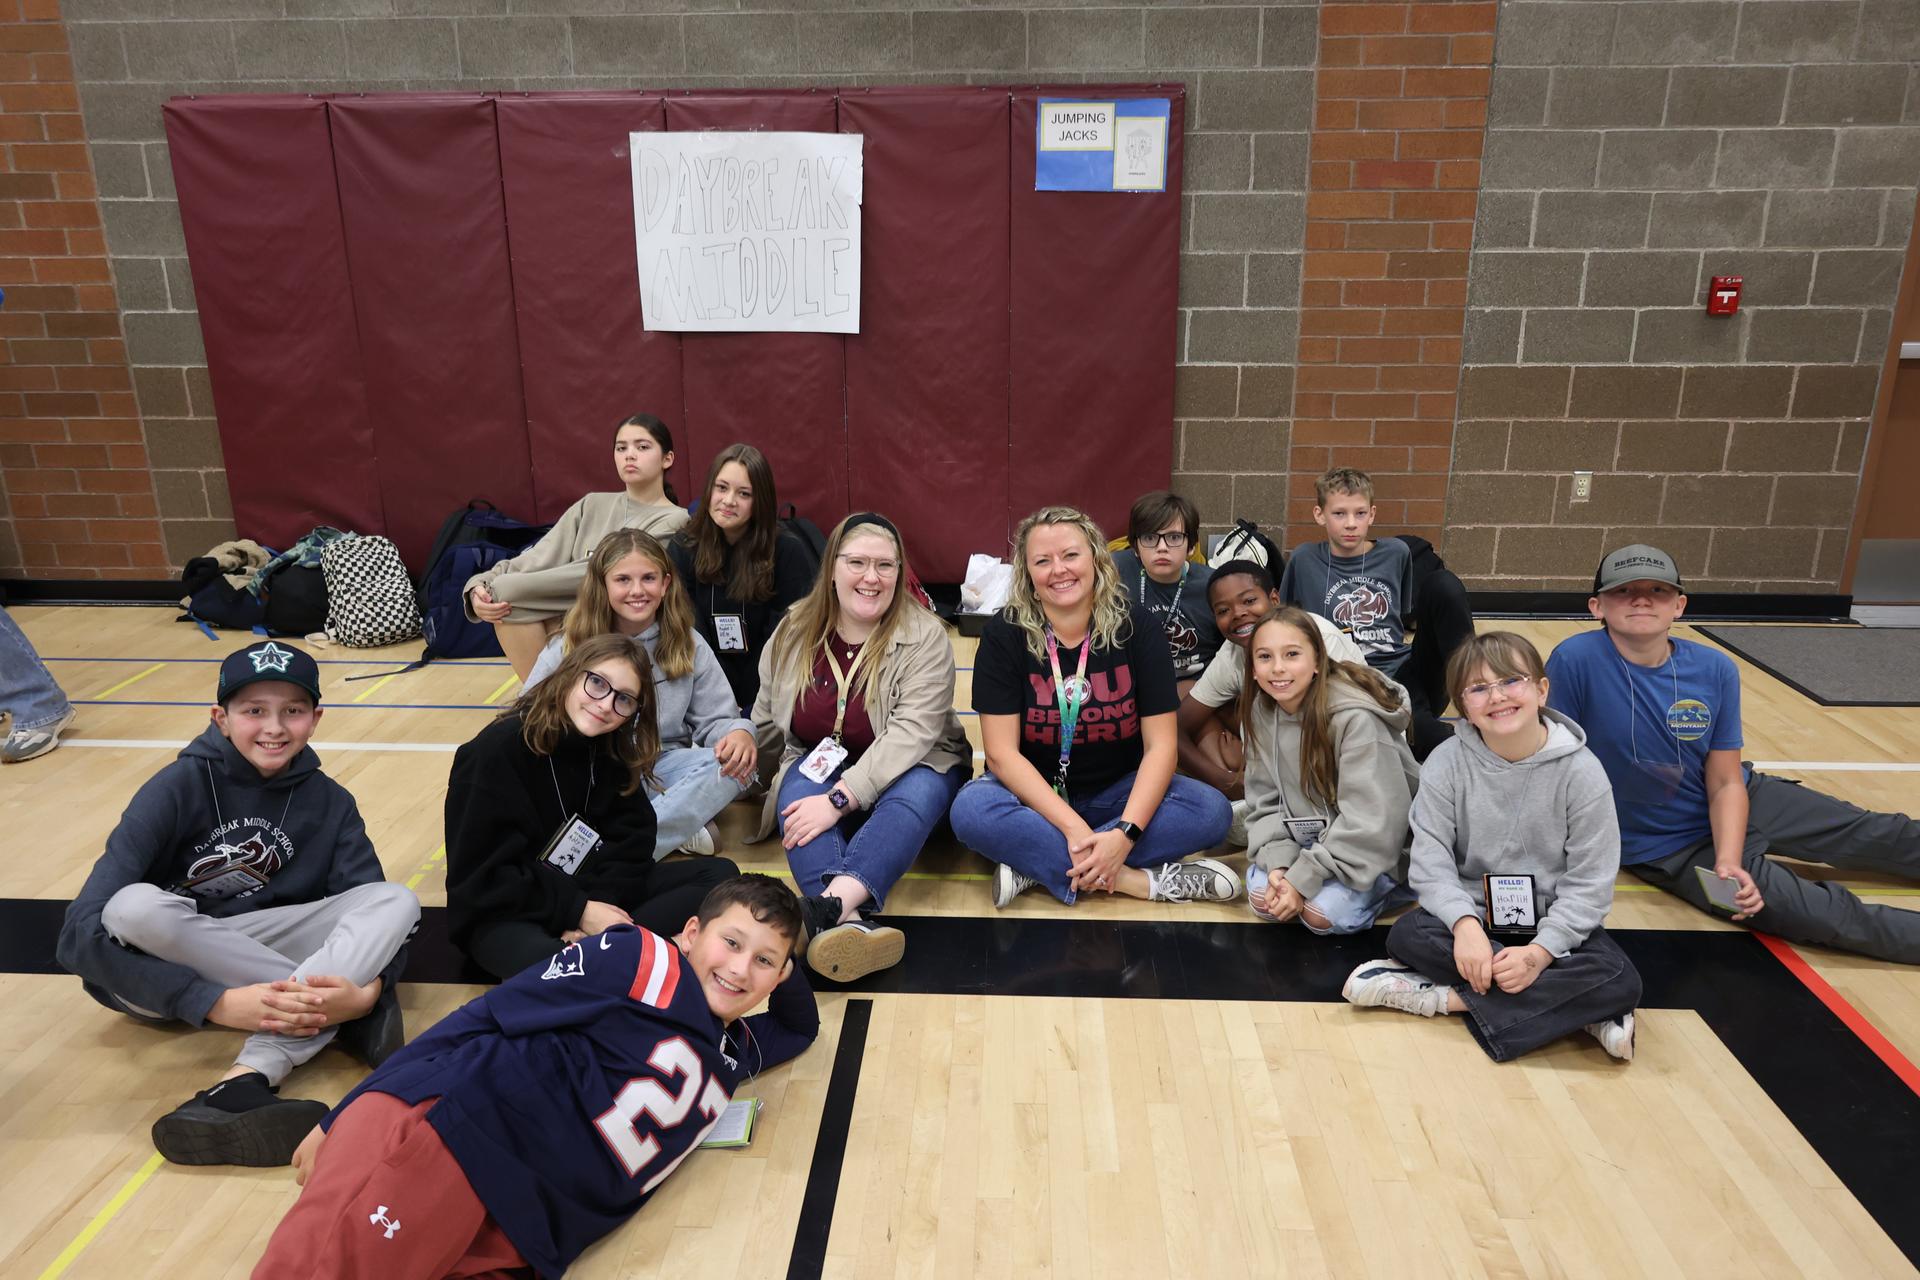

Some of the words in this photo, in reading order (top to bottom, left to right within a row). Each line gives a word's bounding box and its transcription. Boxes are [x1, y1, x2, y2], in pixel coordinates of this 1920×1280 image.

[1051, 112, 1106, 125] JUMPING
[1058, 130, 1098, 141] JACKS
[638, 149, 848, 235] DAYBREAK
[651, 236, 850, 323] MIDDLE
[1614, 556, 1665, 568] BEEFCAKE
[1026, 697, 1137, 724] BEONG
[243, 817, 272, 831] MIDDLE
